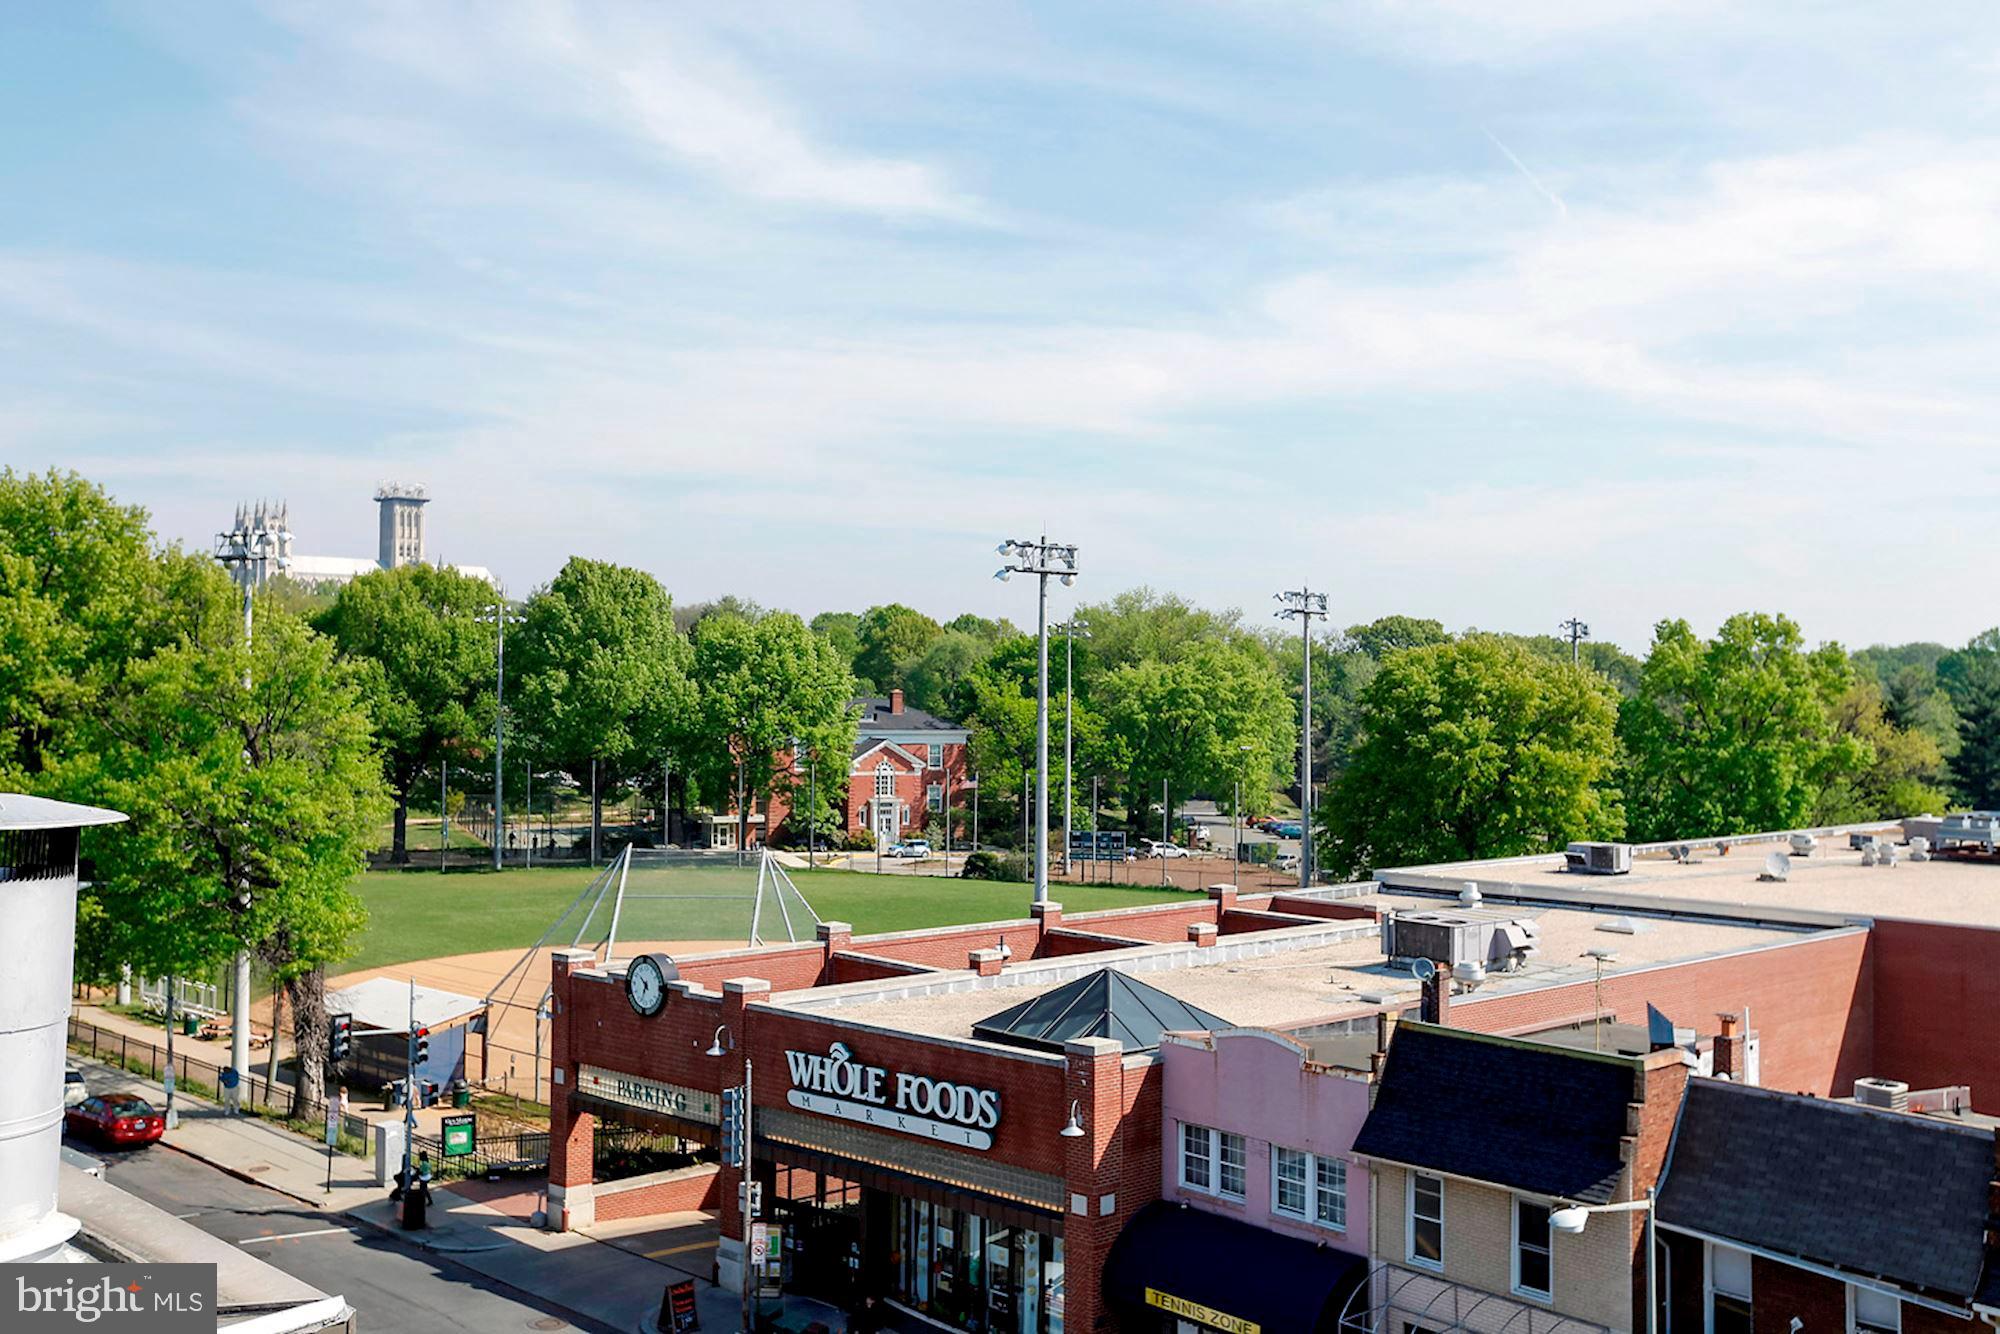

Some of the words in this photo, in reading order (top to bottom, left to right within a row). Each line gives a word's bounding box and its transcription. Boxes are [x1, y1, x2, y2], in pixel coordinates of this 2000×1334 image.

[617, 1080, 687, 1112] PARKING
[785, 1042, 887, 1105] WHOLE
[895, 1072, 1001, 1129] FOODS
[802, 1096, 972, 1144] MARKET
[1153, 1291, 1205, 1320] TENNIS
[1210, 1312, 1252, 1334] ZONE
